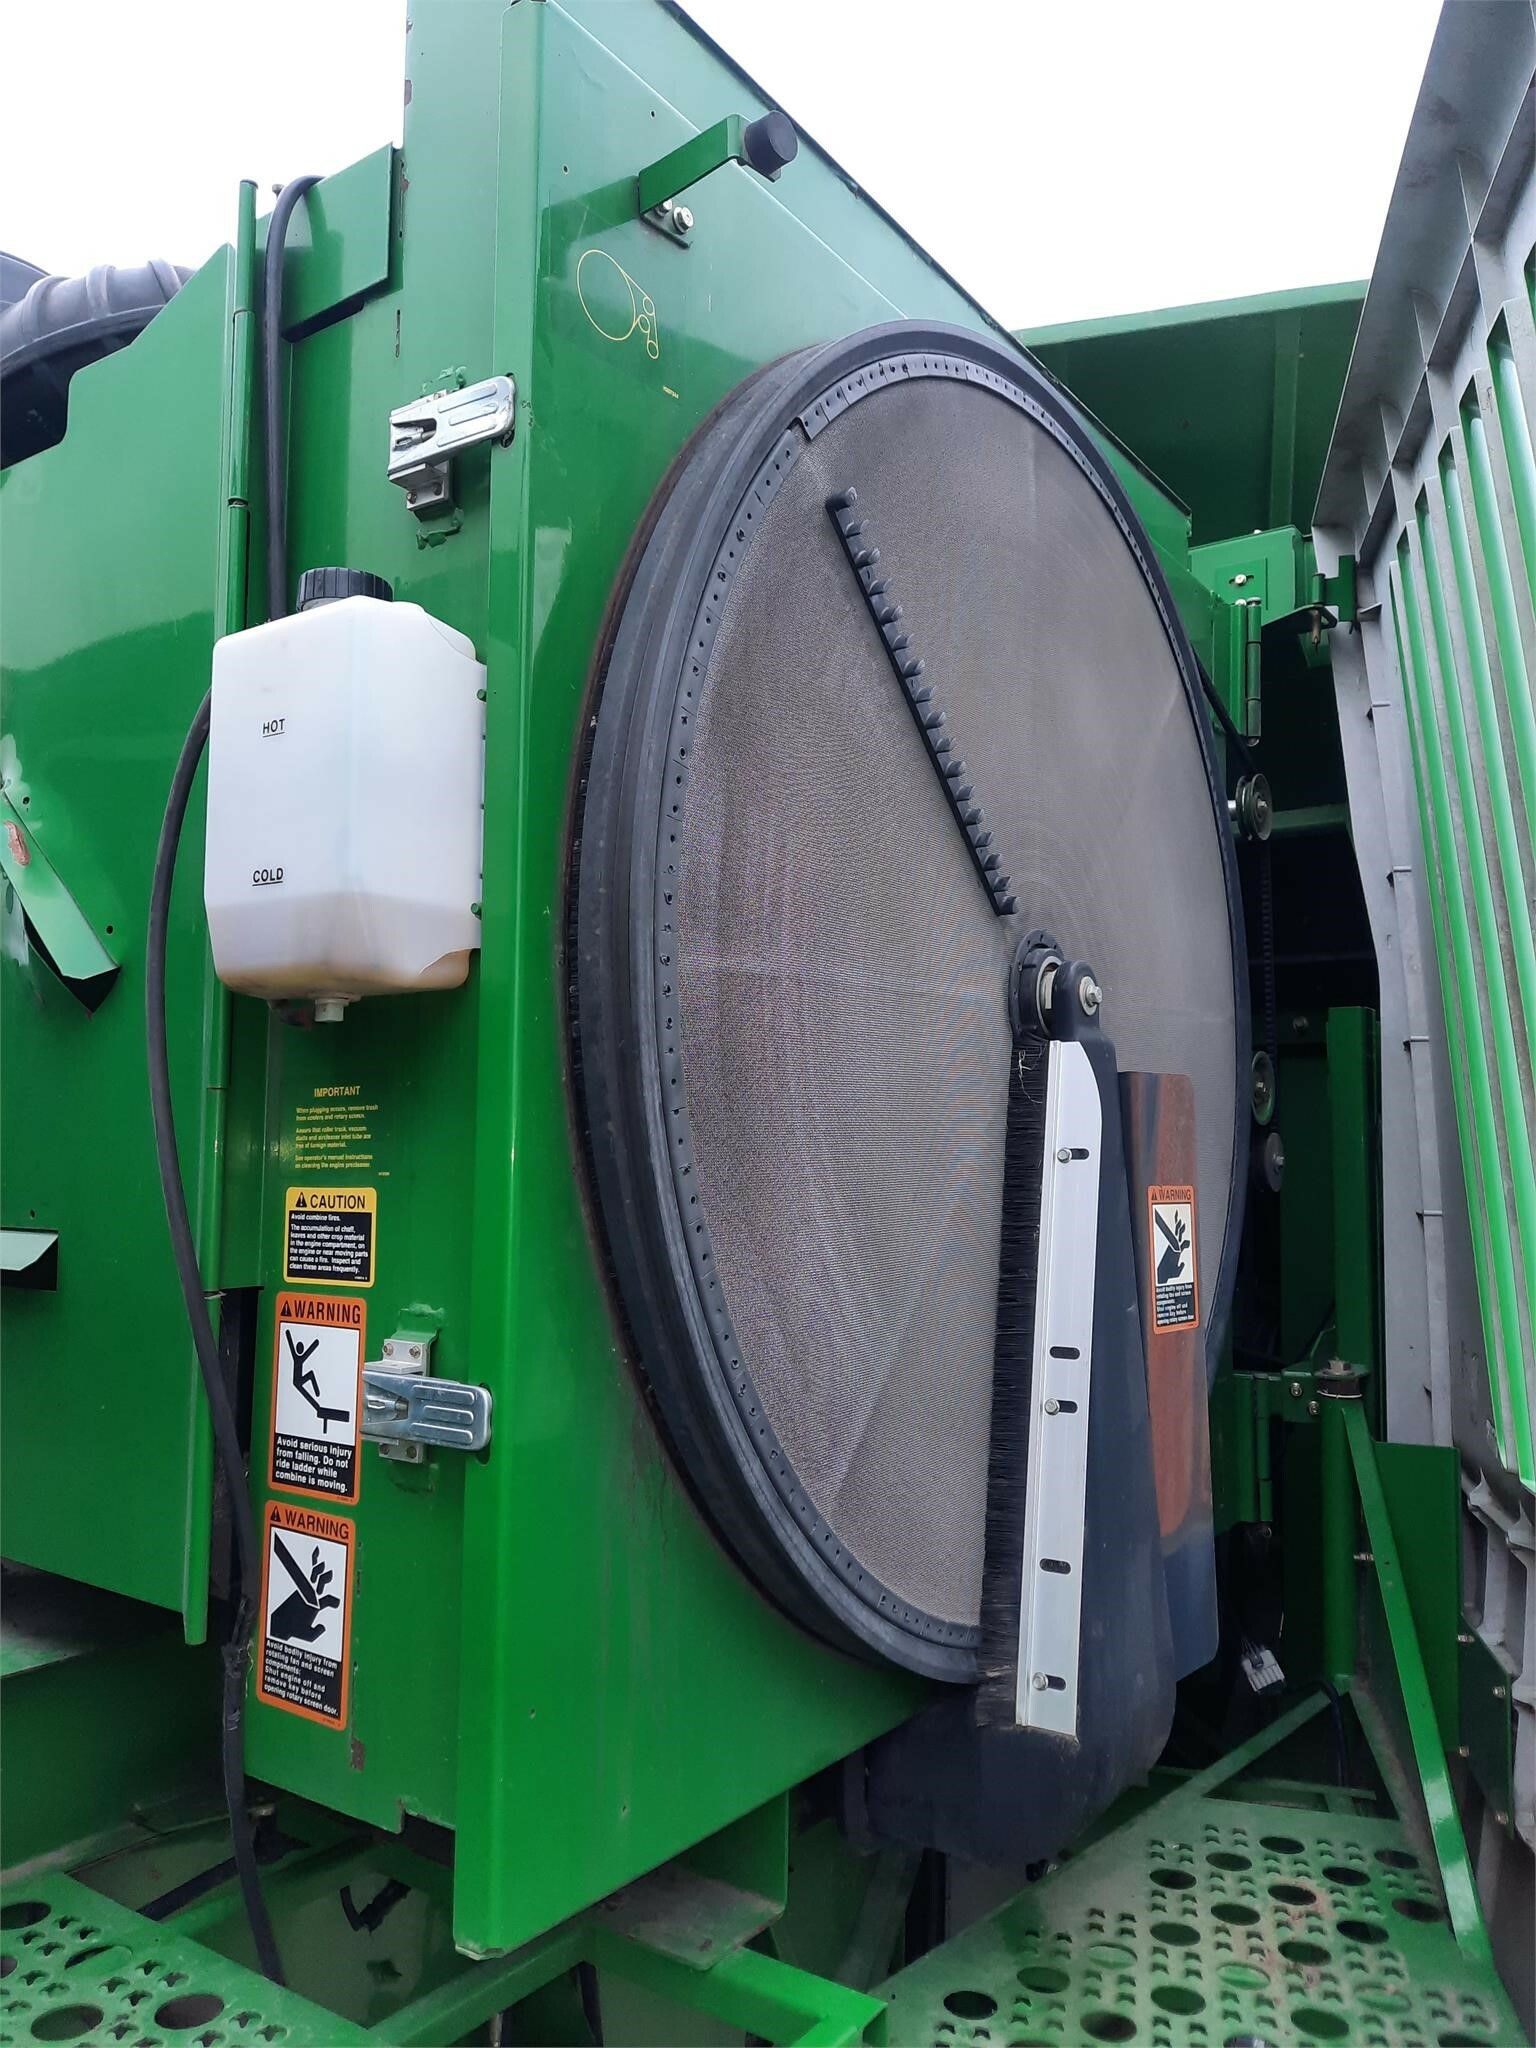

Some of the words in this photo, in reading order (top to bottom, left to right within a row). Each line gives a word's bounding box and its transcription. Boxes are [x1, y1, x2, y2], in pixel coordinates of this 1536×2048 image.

[263, 718, 285, 734] HOT
[253, 868, 283, 883] COLD
[314, 1086, 360, 1097] IMPORTANT
[310, 1195, 365, 1209] CAUTION
[1160, 1190, 1191, 1200] WARNING
[335, 1250, 354, 1258] moving
[333, 1265, 359, 1274] frequently.
[294, 1300, 360, 1324] WARNING
[277, 1437, 298, 1448] Avoid
[300, 1441, 327, 1453] serious
[330, 1445, 352, 1459] injury
[277, 1447, 293, 1458] from
[295, 1450, 320, 1465] falling.
[323, 1456, 333, 1465] Do
[336, 1459, 348, 1468] not
[276, 1459, 290, 1469] ride
[292, 1462, 315, 1473] ladder
[318, 1467, 337, 1478] while
[276, 1471, 306, 1483] combine
[309, 1475, 315, 1484] is
[318, 1479, 347, 1493] moving.
[285, 1509, 349, 1539] WARNING
[266, 1640, 283, 1651] Avoid
[284, 1648, 303, 1659] bodily
[304, 1652, 321, 1665] injury
[323, 1659, 337, 1669] from
[266, 1649, 288, 1663] rotating
[290, 1656, 299, 1665] fan
[301, 1661, 312, 1670] and
[314, 1665, 334, 1678] screen
[265, 1666, 279, 1676] Shut
[281, 1672, 301, 1684] engine
[303, 1679, 312, 1687] off
[314, 1683, 325, 1692] and
[265, 1675, 286, 1688] remove
[288, 1683, 299, 1694] key
[301, 1687, 321, 1700] before
[264, 1684, 285, 1697] opening
[287, 1691, 303, 1704] rotary
[304, 1698, 322, 1710] screen
[324, 1704, 338, 1716] door.
